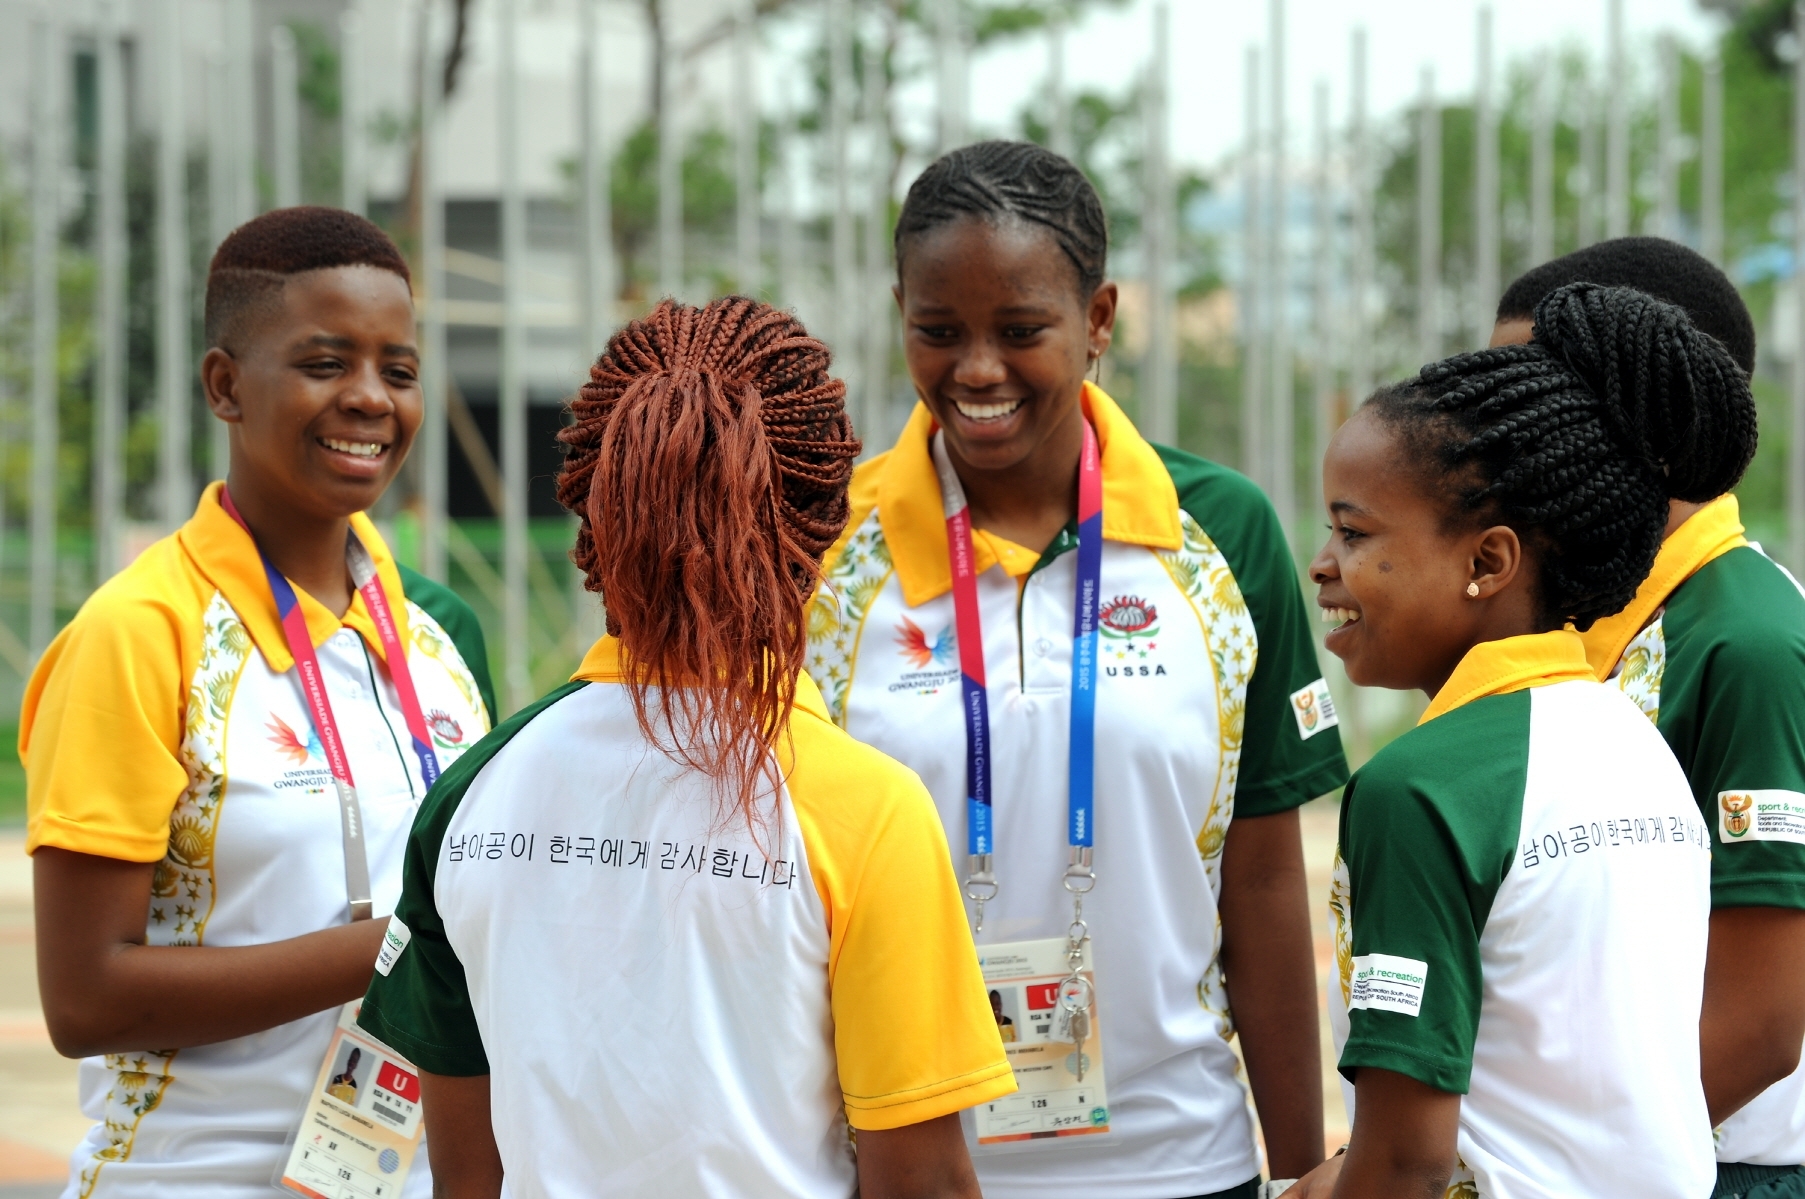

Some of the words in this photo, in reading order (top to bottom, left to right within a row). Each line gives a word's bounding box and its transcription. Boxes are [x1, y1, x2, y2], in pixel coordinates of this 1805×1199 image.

[1106, 664, 1167, 677] USSA
[284, 768, 332, 778] UNIVERSIAD
[273, 776, 328, 789] GWANGJU
[1757, 803, 1781, 813] sport
[1783, 802, 1790, 811] &
[975, 806, 986, 832] 2015
[1522, 820, 1606, 868] 남아공이
[1607, 816, 1666, 847] 한국에게
[449, 832, 535, 862] 남아공이
[549, 835, 650, 869] 한국에게
[660, 841, 797, 890] 감사합니다
[1368, 967, 1375, 975] &
[1376, 969, 1424, 984] recreation
[1375, 994, 1396, 1003] SOUTH
[1396, 998, 1419, 1007] AFRICA
[392, 1073, 408, 1092] U
[1031, 1099, 1048, 1109] 126
[337, 1168, 352, 1181] 126
